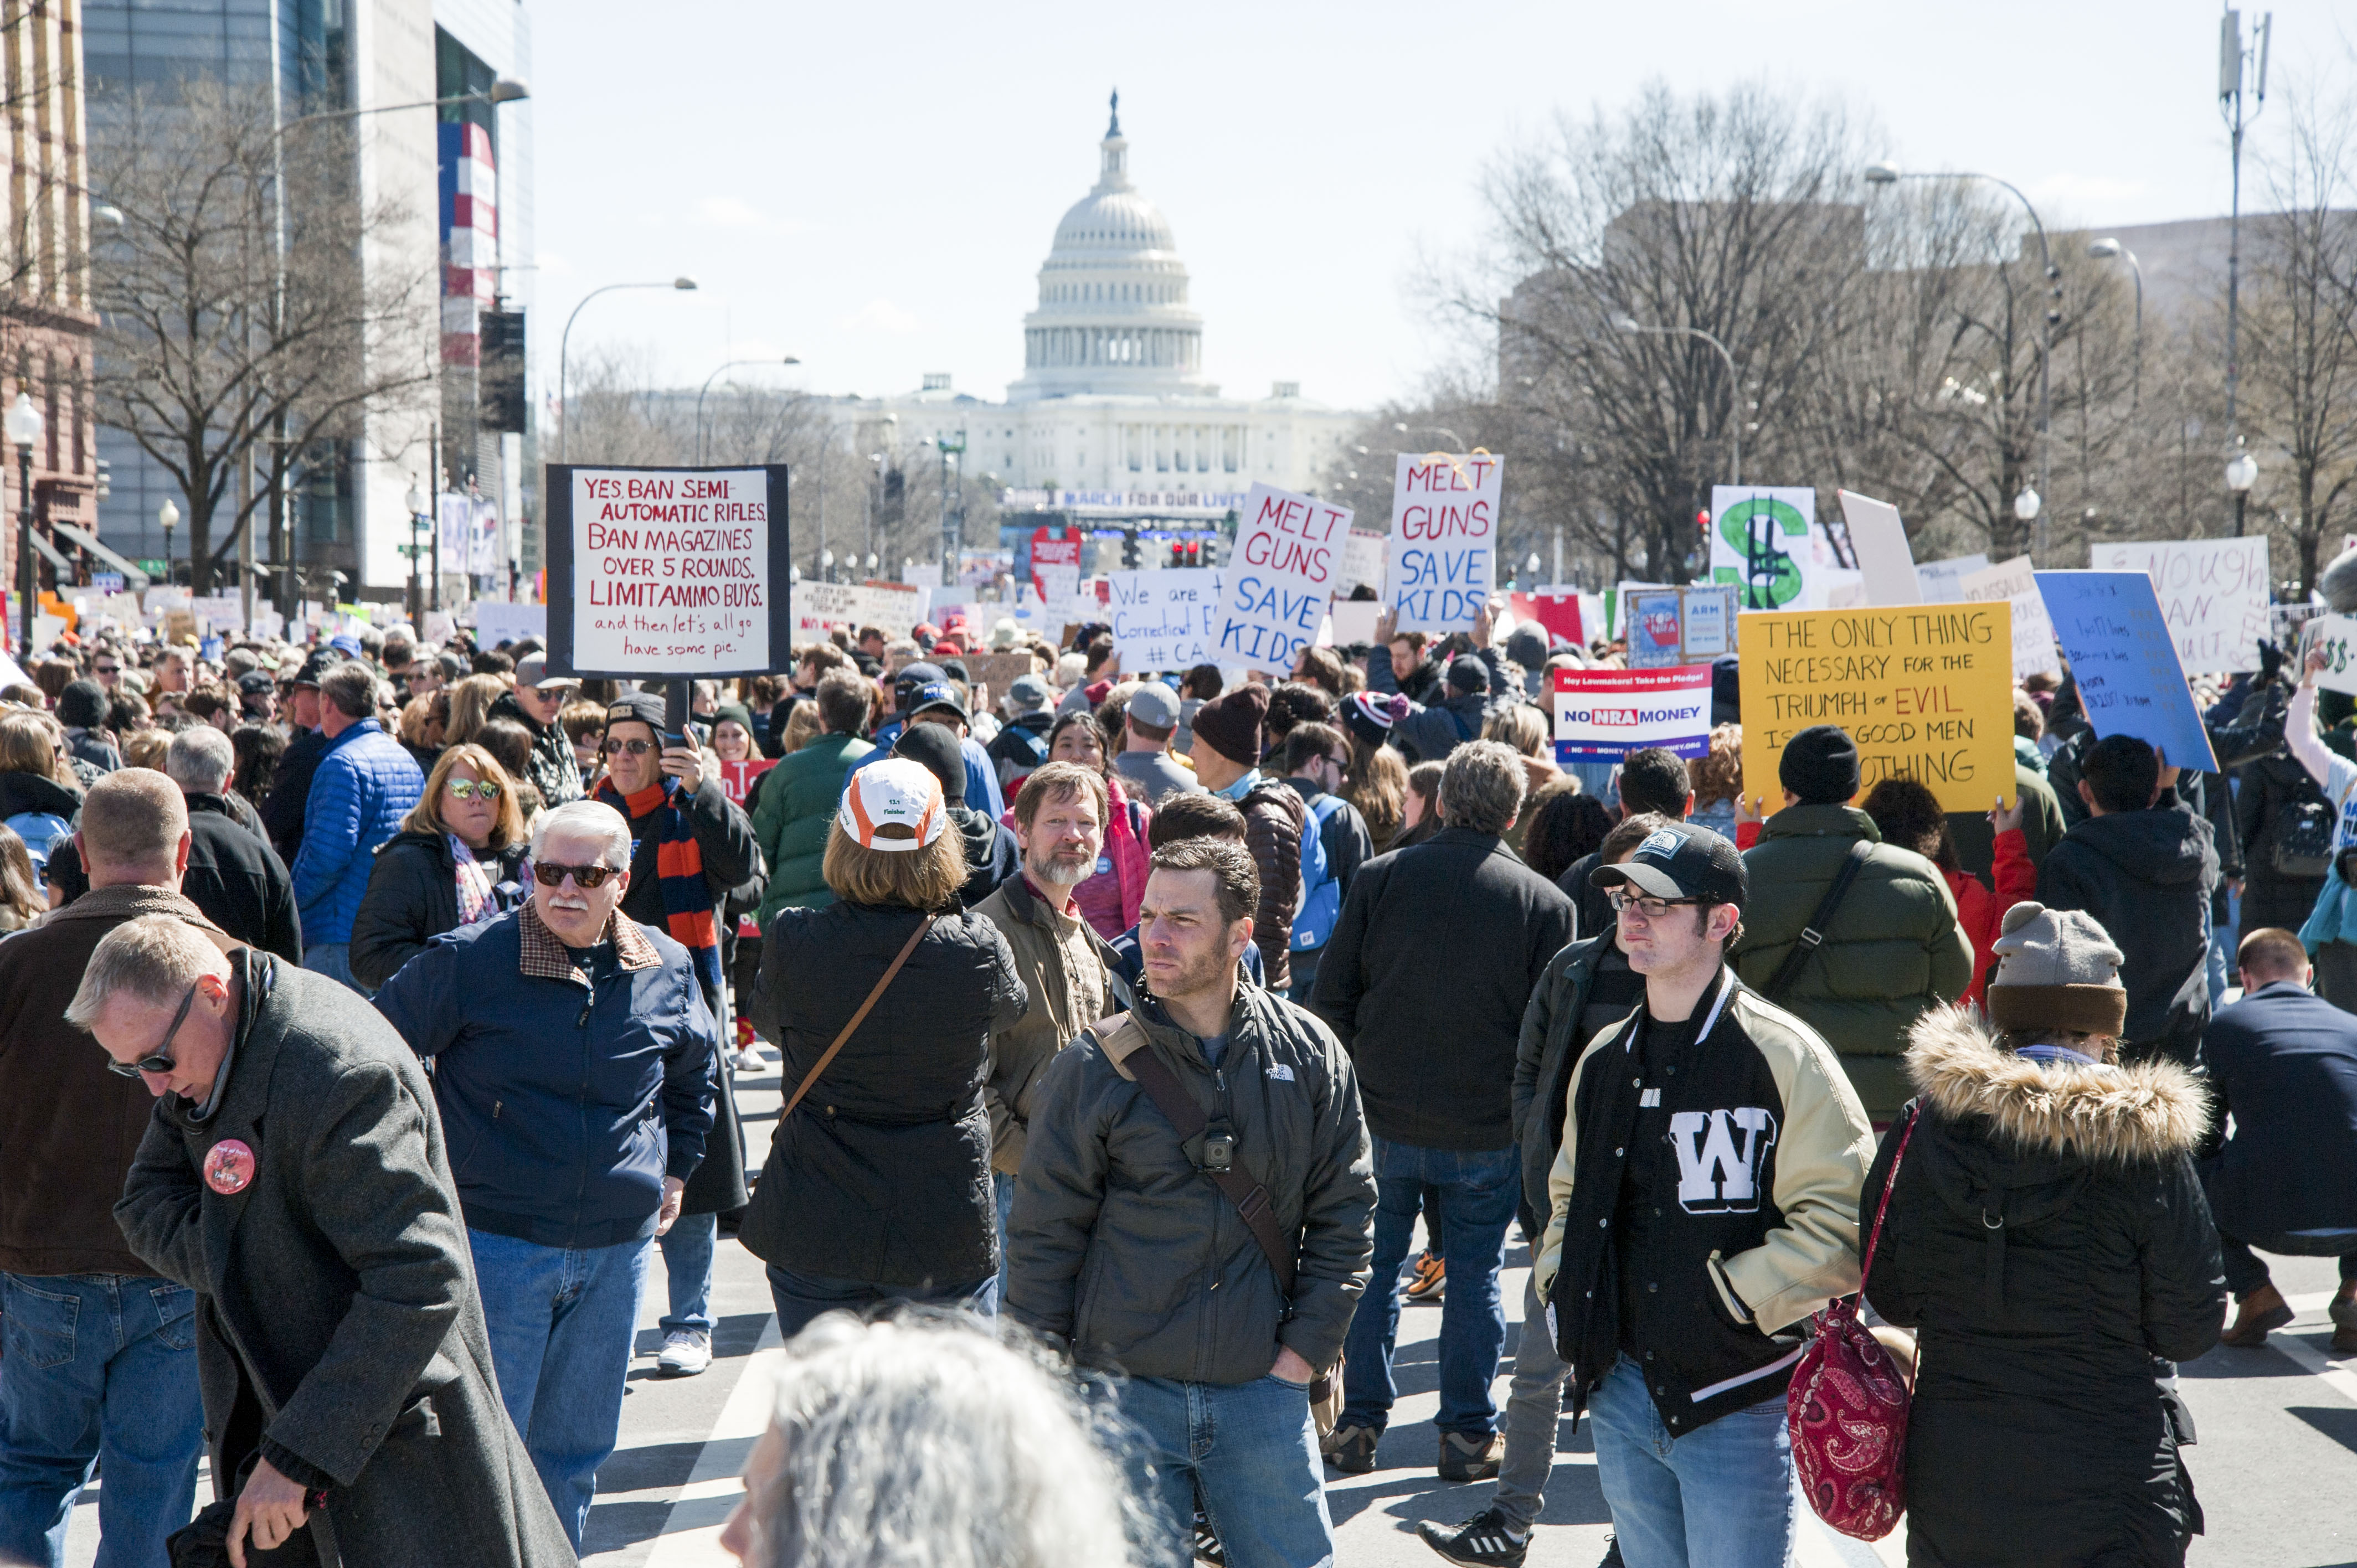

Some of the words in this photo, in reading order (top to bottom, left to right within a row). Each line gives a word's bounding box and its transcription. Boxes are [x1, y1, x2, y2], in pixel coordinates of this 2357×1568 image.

[628, 479, 674, 499] BAN
[1407, 461, 1492, 492] MELT
[600, 503, 709, 523] AUTOMATIC
[714, 503, 766, 523] RIFLES.
[1128, 492, 1159, 507] FOR
[1165, 492, 1198, 507] OUR
[1256, 496, 1345, 543] MELT
[1402, 500, 1489, 540] GUNS
[588, 522, 639, 550] BAN
[644, 528, 753, 553] MAGAZINES
[603, 556, 655, 577] OVER
[662, 558, 676, 576] 5
[682, 557, 755, 579] ROUNDS.
[1246, 532, 1331, 583] GUNS
[1401, 549, 1488, 586] SAVE
[590, 580, 660, 608] LIMIT
[658, 584, 720, 608] AMMO
[724, 583, 763, 608] BUYS.
[1112, 576, 1149, 606] We
[1169, 589, 1198, 602] are
[1234, 576, 1321, 630] SAVE
[1396, 589, 1486, 622] KIDS
[595, 614, 627, 630] and
[634, 615, 668, 633] then
[672, 613, 706, 634] let's
[713, 611, 734, 631] all
[738, 619, 752, 637] go
[2160, 594, 2214, 627] AN
[1220, 617, 1308, 670] KIDS
[1758, 618, 1817, 649] THE
[1831, 616, 1898, 649] ONLY
[1907, 611, 1993, 646] THING
[624, 636, 661, 656] have
[667, 643, 706, 656] some
[1563, 677, 1580, 686] Hey
[1582, 676, 1633, 685] Lawmakers!
[1635, 675, 1655, 685] Take
[1656, 675, 1671, 684] the
[1672, 672, 1704, 683] Pledge!
[1766, 654, 1891, 685] NECESSARY
[1904, 656, 1934, 673] FOR
[1940, 653, 1974, 670] THE
[1565, 710, 1591, 723] NO
[1593, 710, 1636, 725] NRA
[1639, 705, 1701, 723] MONEY
[1766, 691, 1867, 720] TRIUMPH
[1895, 685, 1964, 715] EVIL
[1855, 721, 1917, 744] GOOD
[1927, 718, 1974, 742] MEN
[1859, 749, 1975, 788] OTHING
[1669, 1107, 1777, 1215] W
